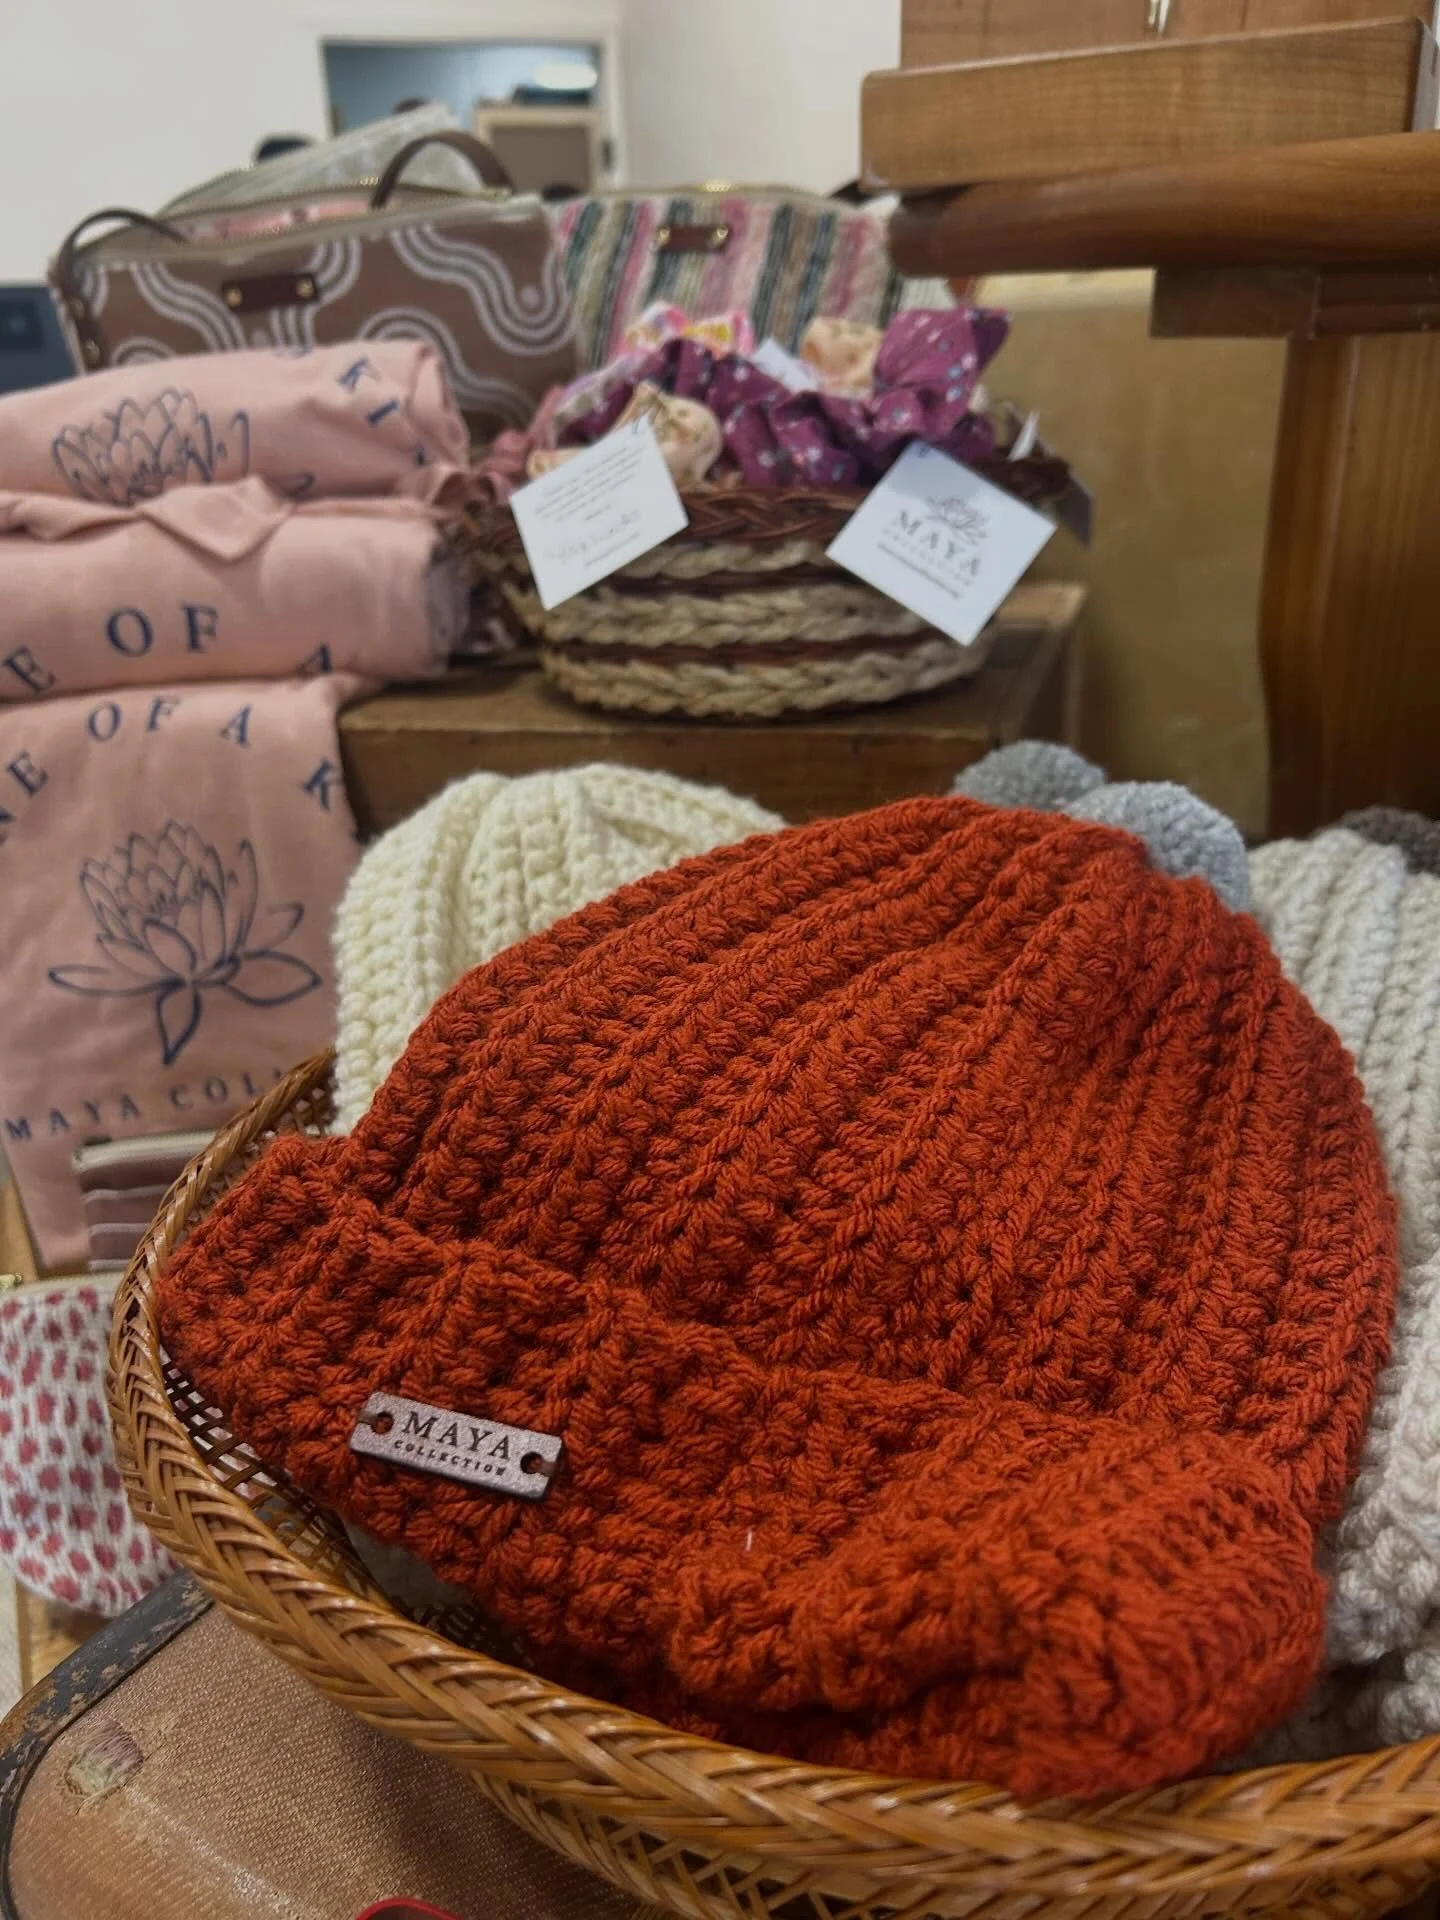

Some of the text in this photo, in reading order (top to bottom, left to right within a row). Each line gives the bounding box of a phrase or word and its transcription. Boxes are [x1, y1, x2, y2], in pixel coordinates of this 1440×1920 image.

[885, 510, 981, 577] MAYA
[106, 602, 219, 658] OF
[88, 695, 181, 742] OF
[219, 704, 252, 749] A
[4, 1067, 284, 1142] MAYA COL
[393, 1439, 507, 1476] COLLECTION
[401, 1410, 511, 1461] MAYA
